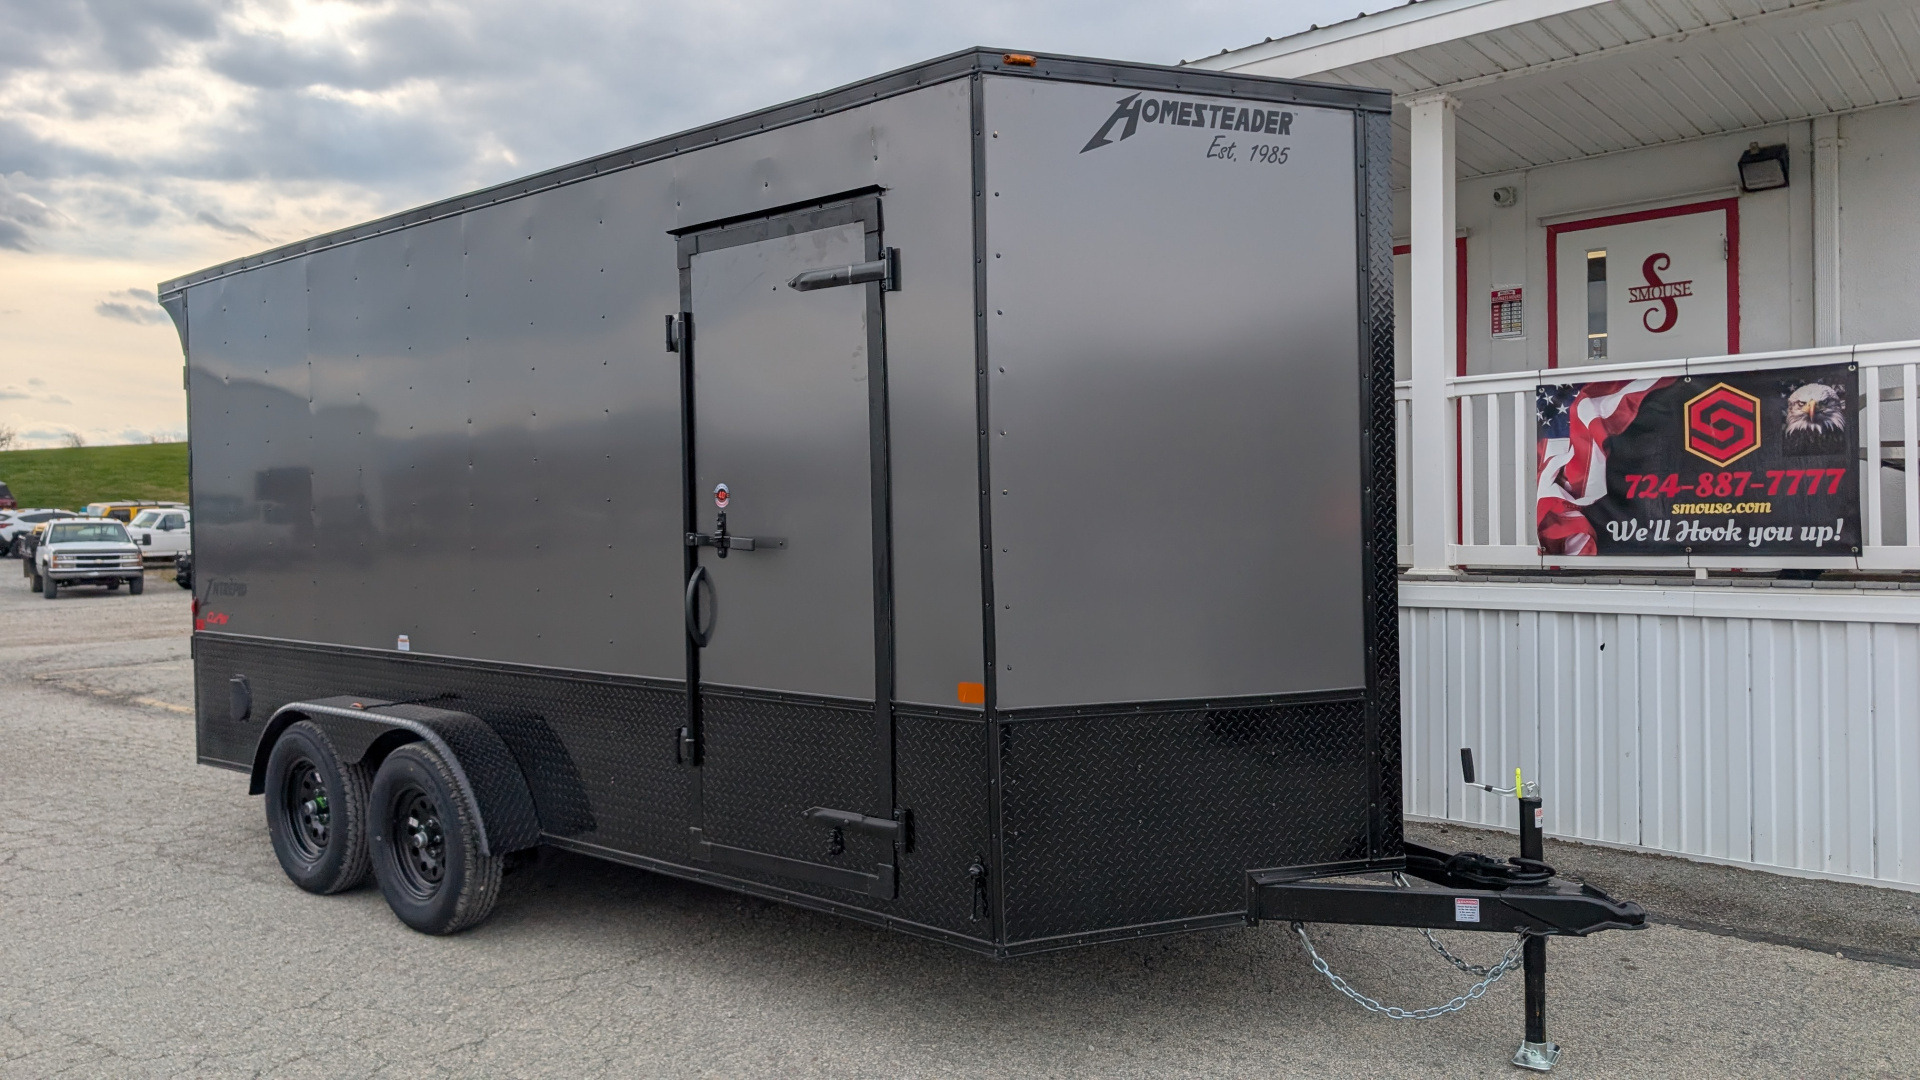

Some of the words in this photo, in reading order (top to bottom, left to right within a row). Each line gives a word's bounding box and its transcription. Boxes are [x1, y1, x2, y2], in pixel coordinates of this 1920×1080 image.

[1079, 92, 1294, 154] HOMESTEADER
[1206, 135, 1237, 162] Est.
[1249, 144, 1291, 164] 1985
[1629, 283, 1692, 302] SMOUSE
[1625, 468, 1846, 499] 724-887-7777
[1672, 501, 1772, 515] smouse.com
[1606, 518, 1671, 541] We'll
[1676, 518, 1742, 542] Hook
[1748, 525, 1794, 547] you
[1800, 518, 1844, 548] up!
